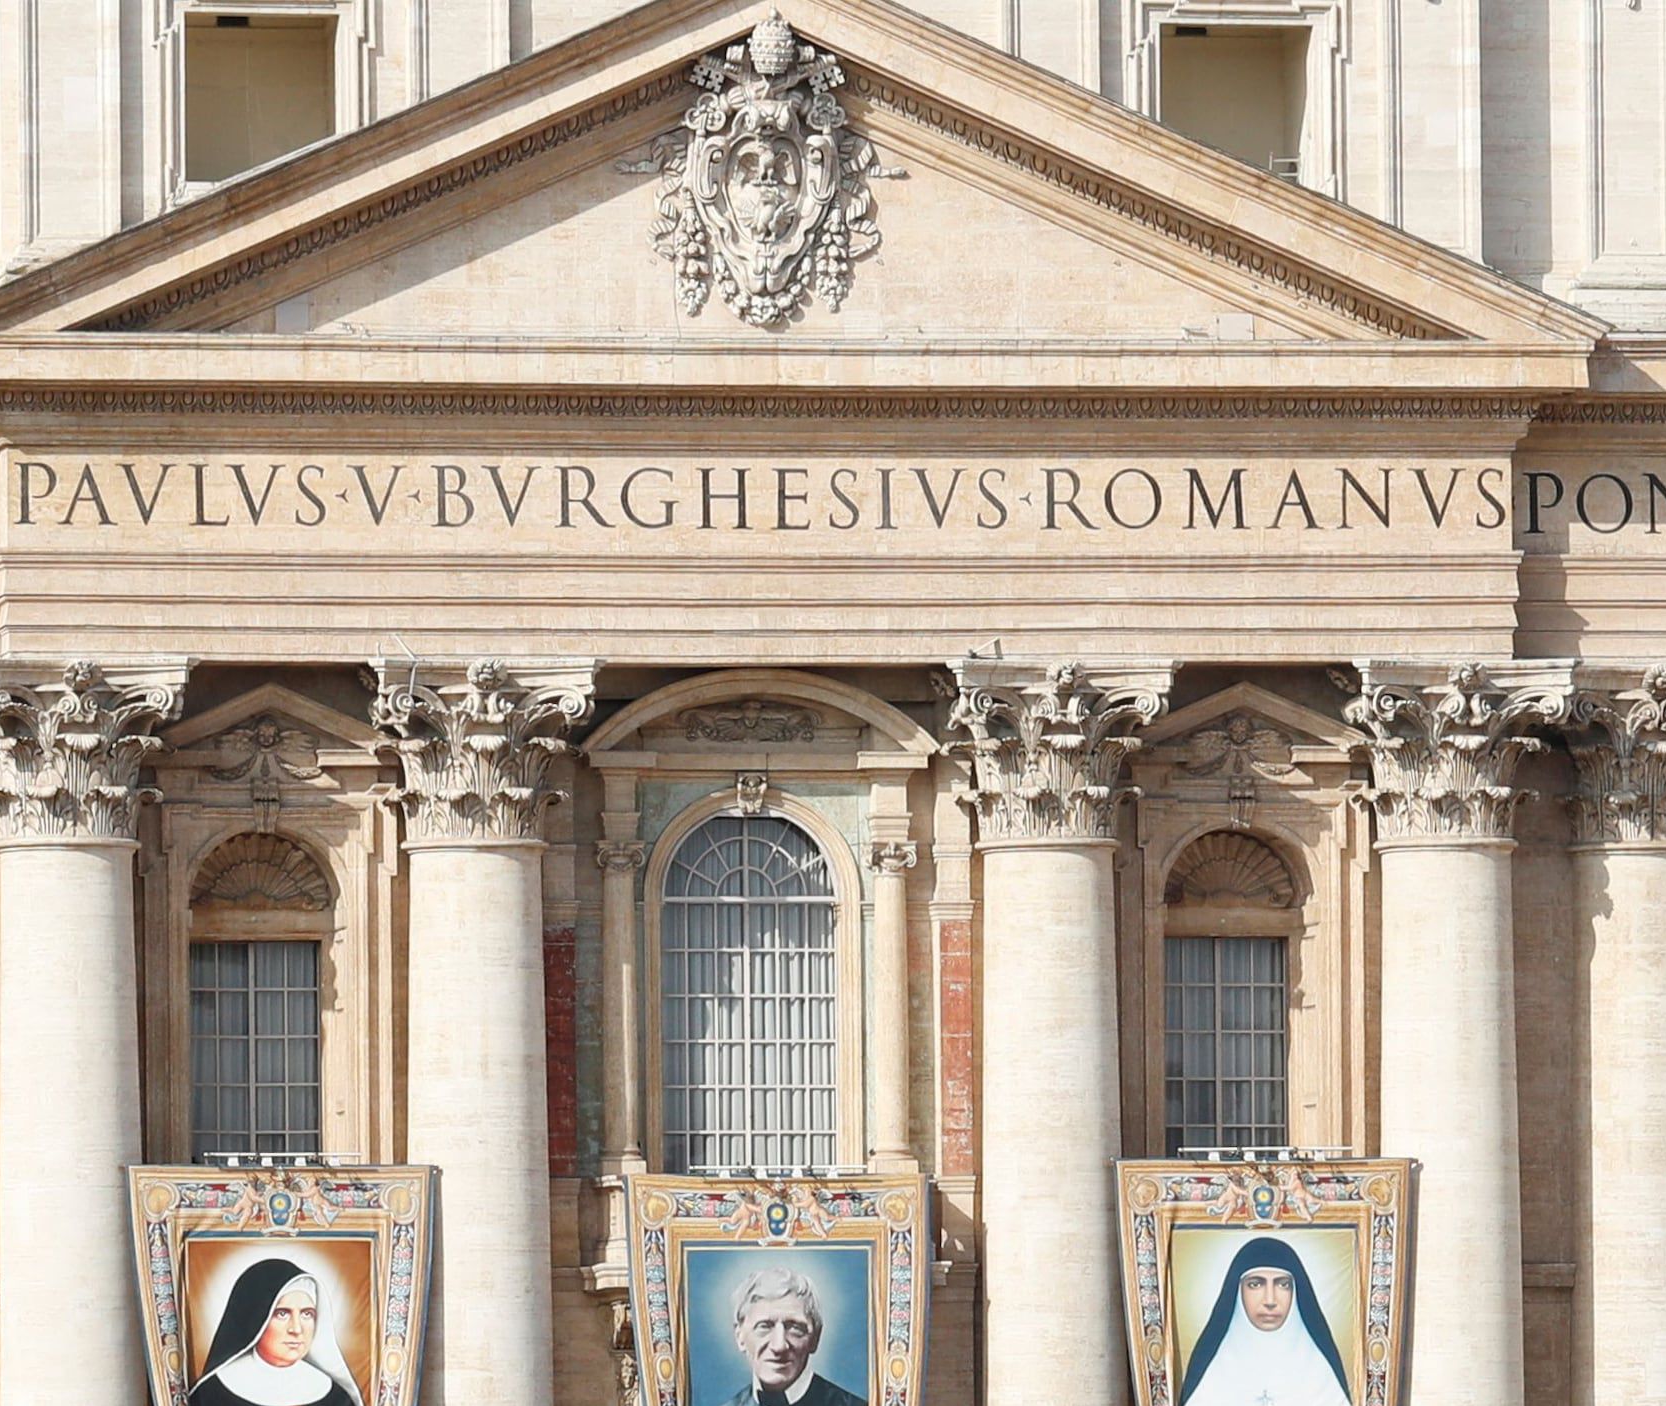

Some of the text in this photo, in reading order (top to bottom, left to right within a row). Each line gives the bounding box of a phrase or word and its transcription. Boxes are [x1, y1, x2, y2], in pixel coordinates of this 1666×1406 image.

[12, 462, 327, 529] PAVLVS
[353, 465, 402, 528] V
[430, 464, 1013, 533] BVRGHESIVS
[1039, 466, 1508, 532] ROMANVS
